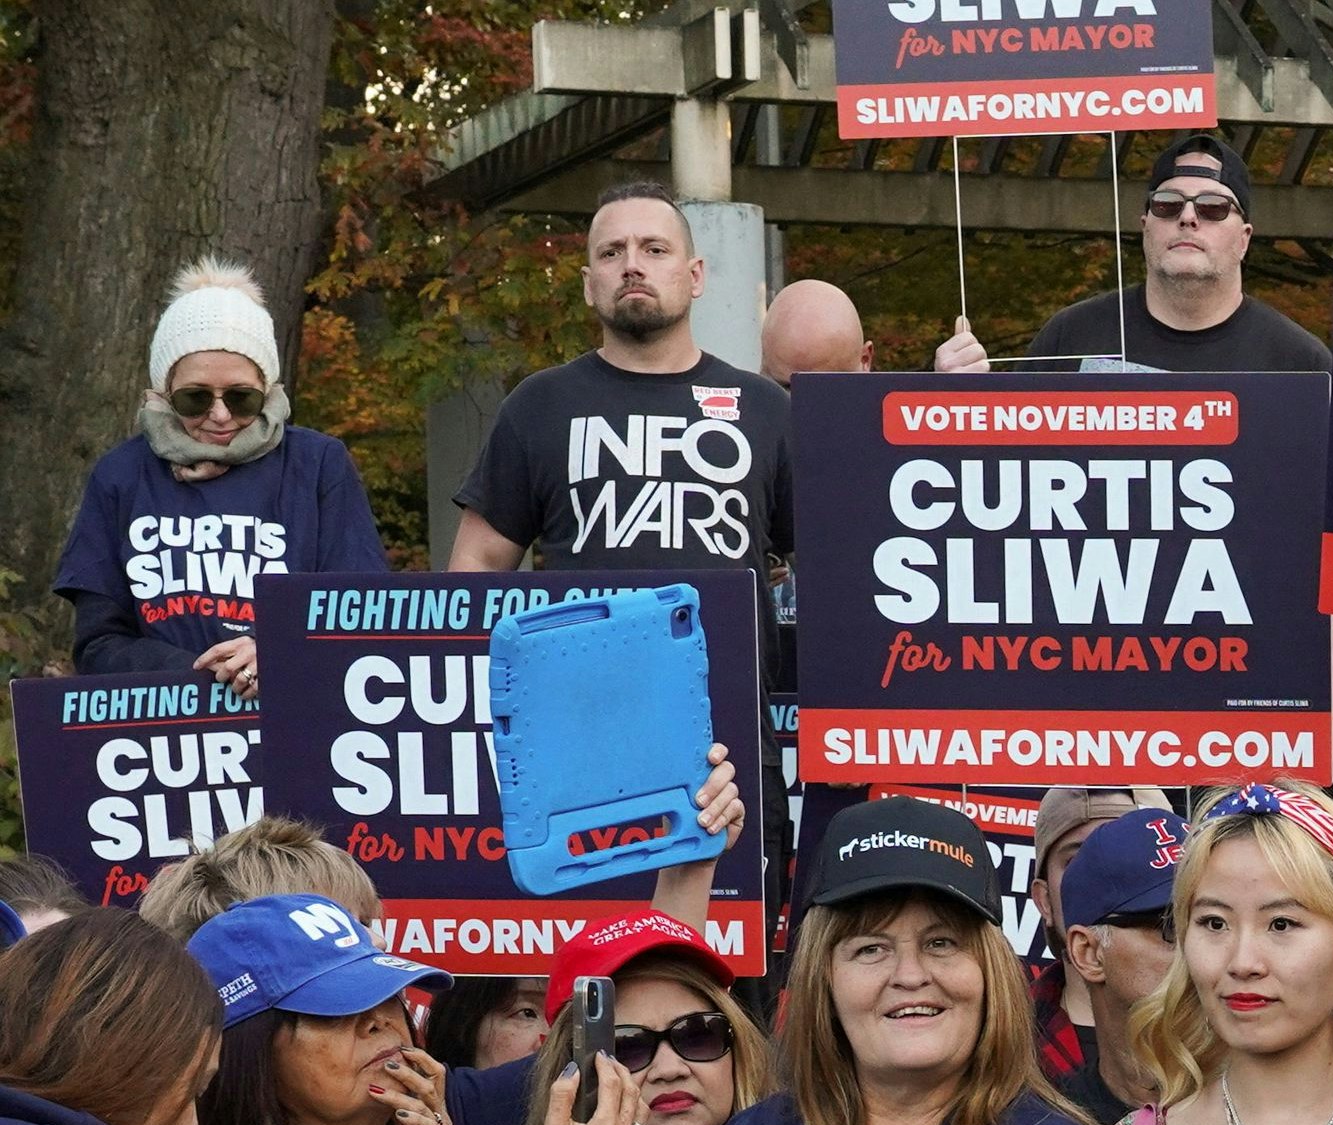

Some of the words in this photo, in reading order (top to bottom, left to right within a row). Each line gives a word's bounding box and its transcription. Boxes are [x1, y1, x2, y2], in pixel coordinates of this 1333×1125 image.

[896, 28, 944, 68] for
[952, 28, 1022, 53] NYC
[1030, 24, 1154, 52] MAYOR
[857, 88, 1203, 124] SLIWAFORNYC.COM
[901, 406, 987, 430] VOTE
[994, 406, 1176, 430] NOVEMBER
[1184, 401, 1231, 430] 4TH
[568, 415, 752, 485] INFO
[890, 459, 1234, 531] CURTIS
[129, 515, 286, 558] CURTIS
[570, 480, 749, 559] WARS
[873, 537, 1253, 624] SLIWA
[166, 595, 215, 617] NYC
[308, 589, 470, 630] FIGHTING
[881, 631, 951, 688] for
[962, 636, 1061, 670] NYC
[1072, 636, 1248, 671] MAYOR
[63, 684, 198, 723] FIGHTING
[96, 730, 261, 792] CUR
[824, 728, 1313, 767] SLIWAFORNYC.COM
[329, 730, 501, 816] SLI
[945, 799, 1039, 828] NOVEM
[346, 821, 405, 862] for
[415, 827, 507, 862] NYC
[859, 830, 974, 868] stickermule
[587, 919, 629, 939] MAKE
[633, 915, 694, 937] AMERICA
[593, 925, 643, 946] GREAT
[651, 923, 692, 942] AGAIN
[218, 972, 254, 999] PETH
